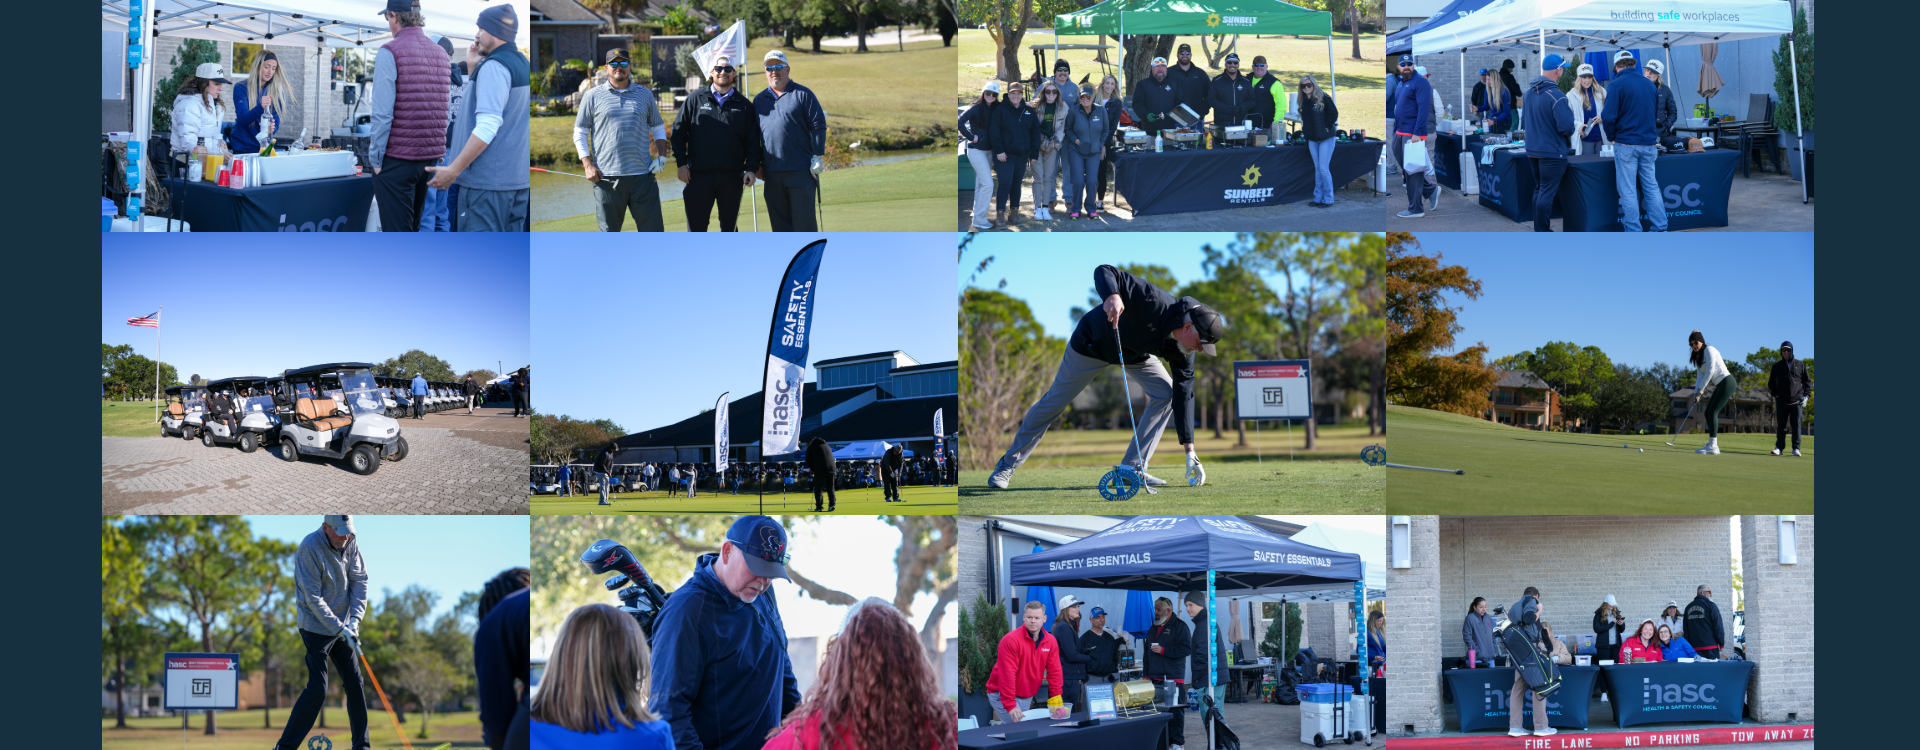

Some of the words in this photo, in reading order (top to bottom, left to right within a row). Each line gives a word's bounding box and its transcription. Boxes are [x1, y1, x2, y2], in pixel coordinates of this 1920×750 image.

[1610, 10, 1655, 22] building
[1657, 9, 1681, 20] safe
[1682, 11, 1740, 23] workplaces
[1224, 188, 1274, 199] SUNBELT
[1674, 209, 1702, 217] COUNCIL
[781, 279, 804, 347] SAFETY
[795, 280, 813, 348] ESSENTIALS
[1238, 369, 1257, 377] hasc
[1049, 558, 1084, 571] SAFETY
[1086, 552, 1151, 567] ESSENTIALS
[1253, 550, 1286, 563] SAFETY
[1287, 553, 1332, 567] ESSENTIALS
[168, 660, 187, 668] hasc
[1643, 677, 1716, 705] hasc
[1625, 735, 1640, 746] NO
[1650, 733, 1700, 745] PARKING
[1731, 731, 1754, 742] TOW
[1764, 729, 1794, 740] AWAY
[1525, 738, 1551, 749] FIRE
[1561, 737, 1592, 749] LANE
